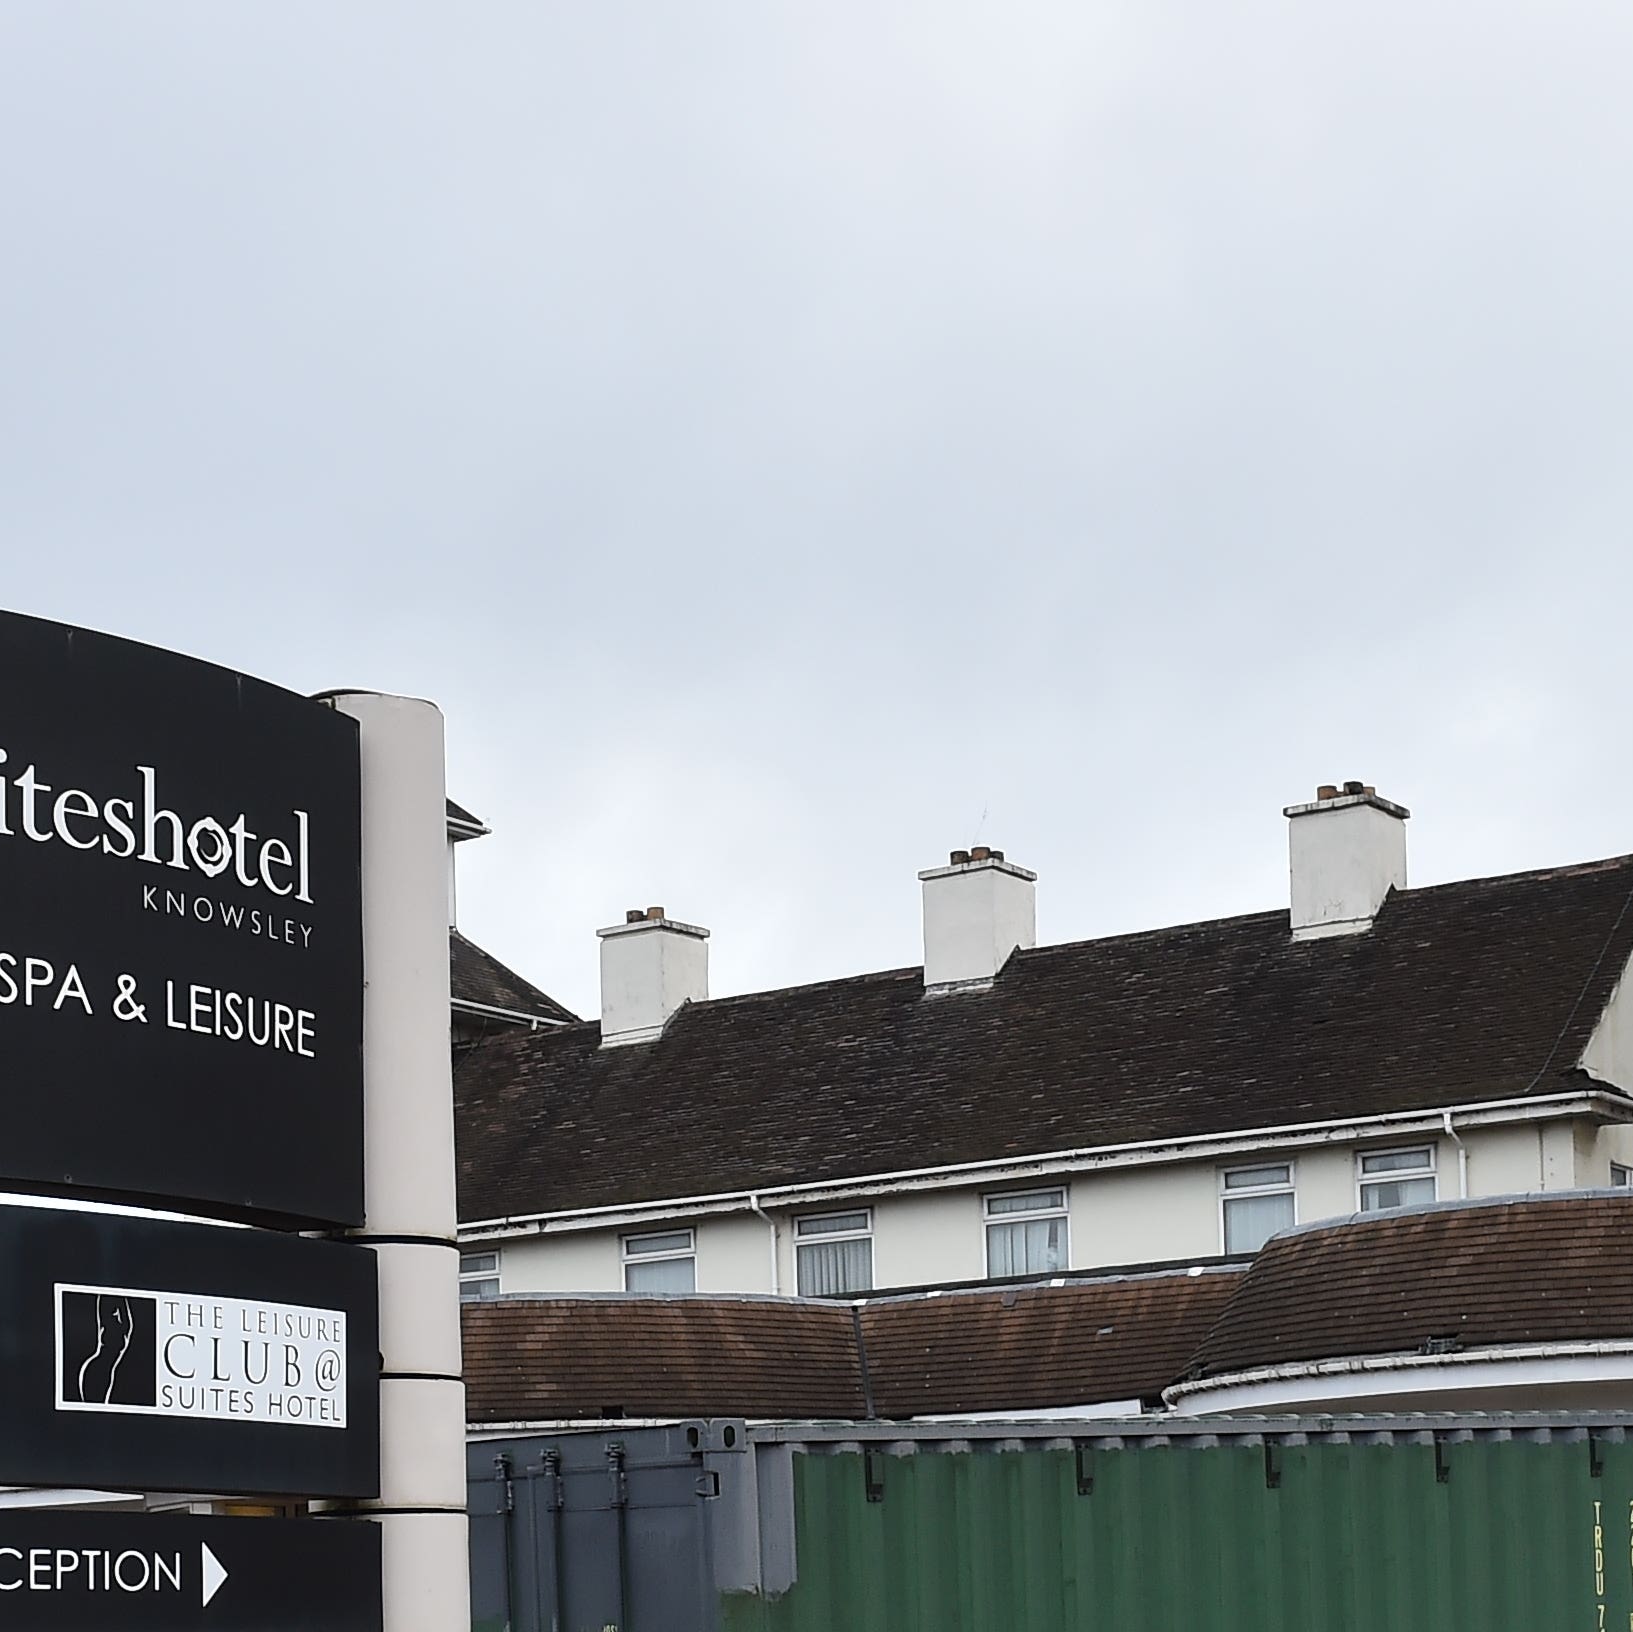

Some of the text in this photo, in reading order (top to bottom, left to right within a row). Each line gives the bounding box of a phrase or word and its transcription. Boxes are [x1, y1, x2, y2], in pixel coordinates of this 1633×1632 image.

[144, 885, 312, 948] KNOWSLEY
[112, 974, 148, 1023] &
[167, 980, 315, 1057] LEISURE
[164, 1302, 340, 1342] THE LEISURE
[162, 1385, 340, 1421] SUITES HOTEL
[1592, 1501, 1604, 1596] TRDU
